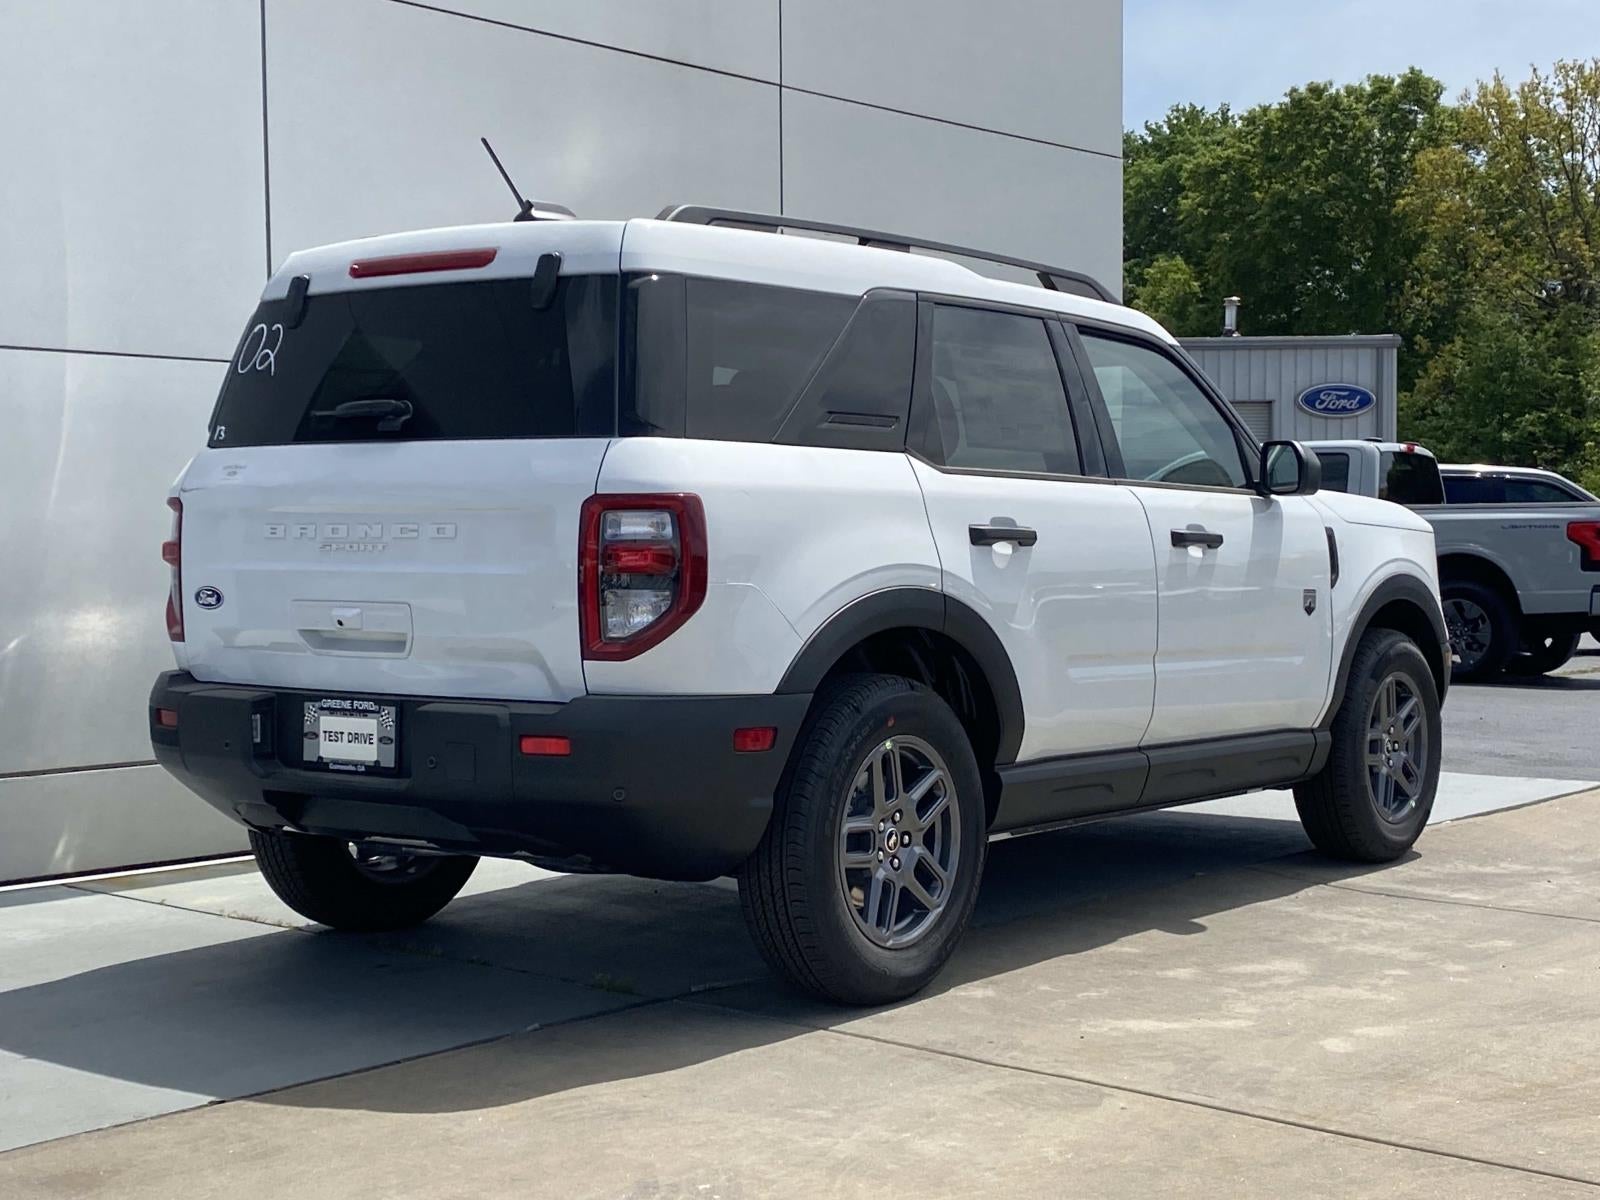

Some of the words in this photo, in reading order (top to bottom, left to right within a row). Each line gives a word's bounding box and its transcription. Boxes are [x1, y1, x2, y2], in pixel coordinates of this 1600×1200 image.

[237, 323, 284, 376] 02
[1315, 390, 1360, 410] Ford
[263, 523, 458, 540] BRONCO
[319, 542, 389, 553] SPORT
[321, 699, 352, 710] GREENE
[353, 700, 375, 711] FORD
[322, 730, 345, 743] TEST
[347, 732, 374, 745] DRIVE
